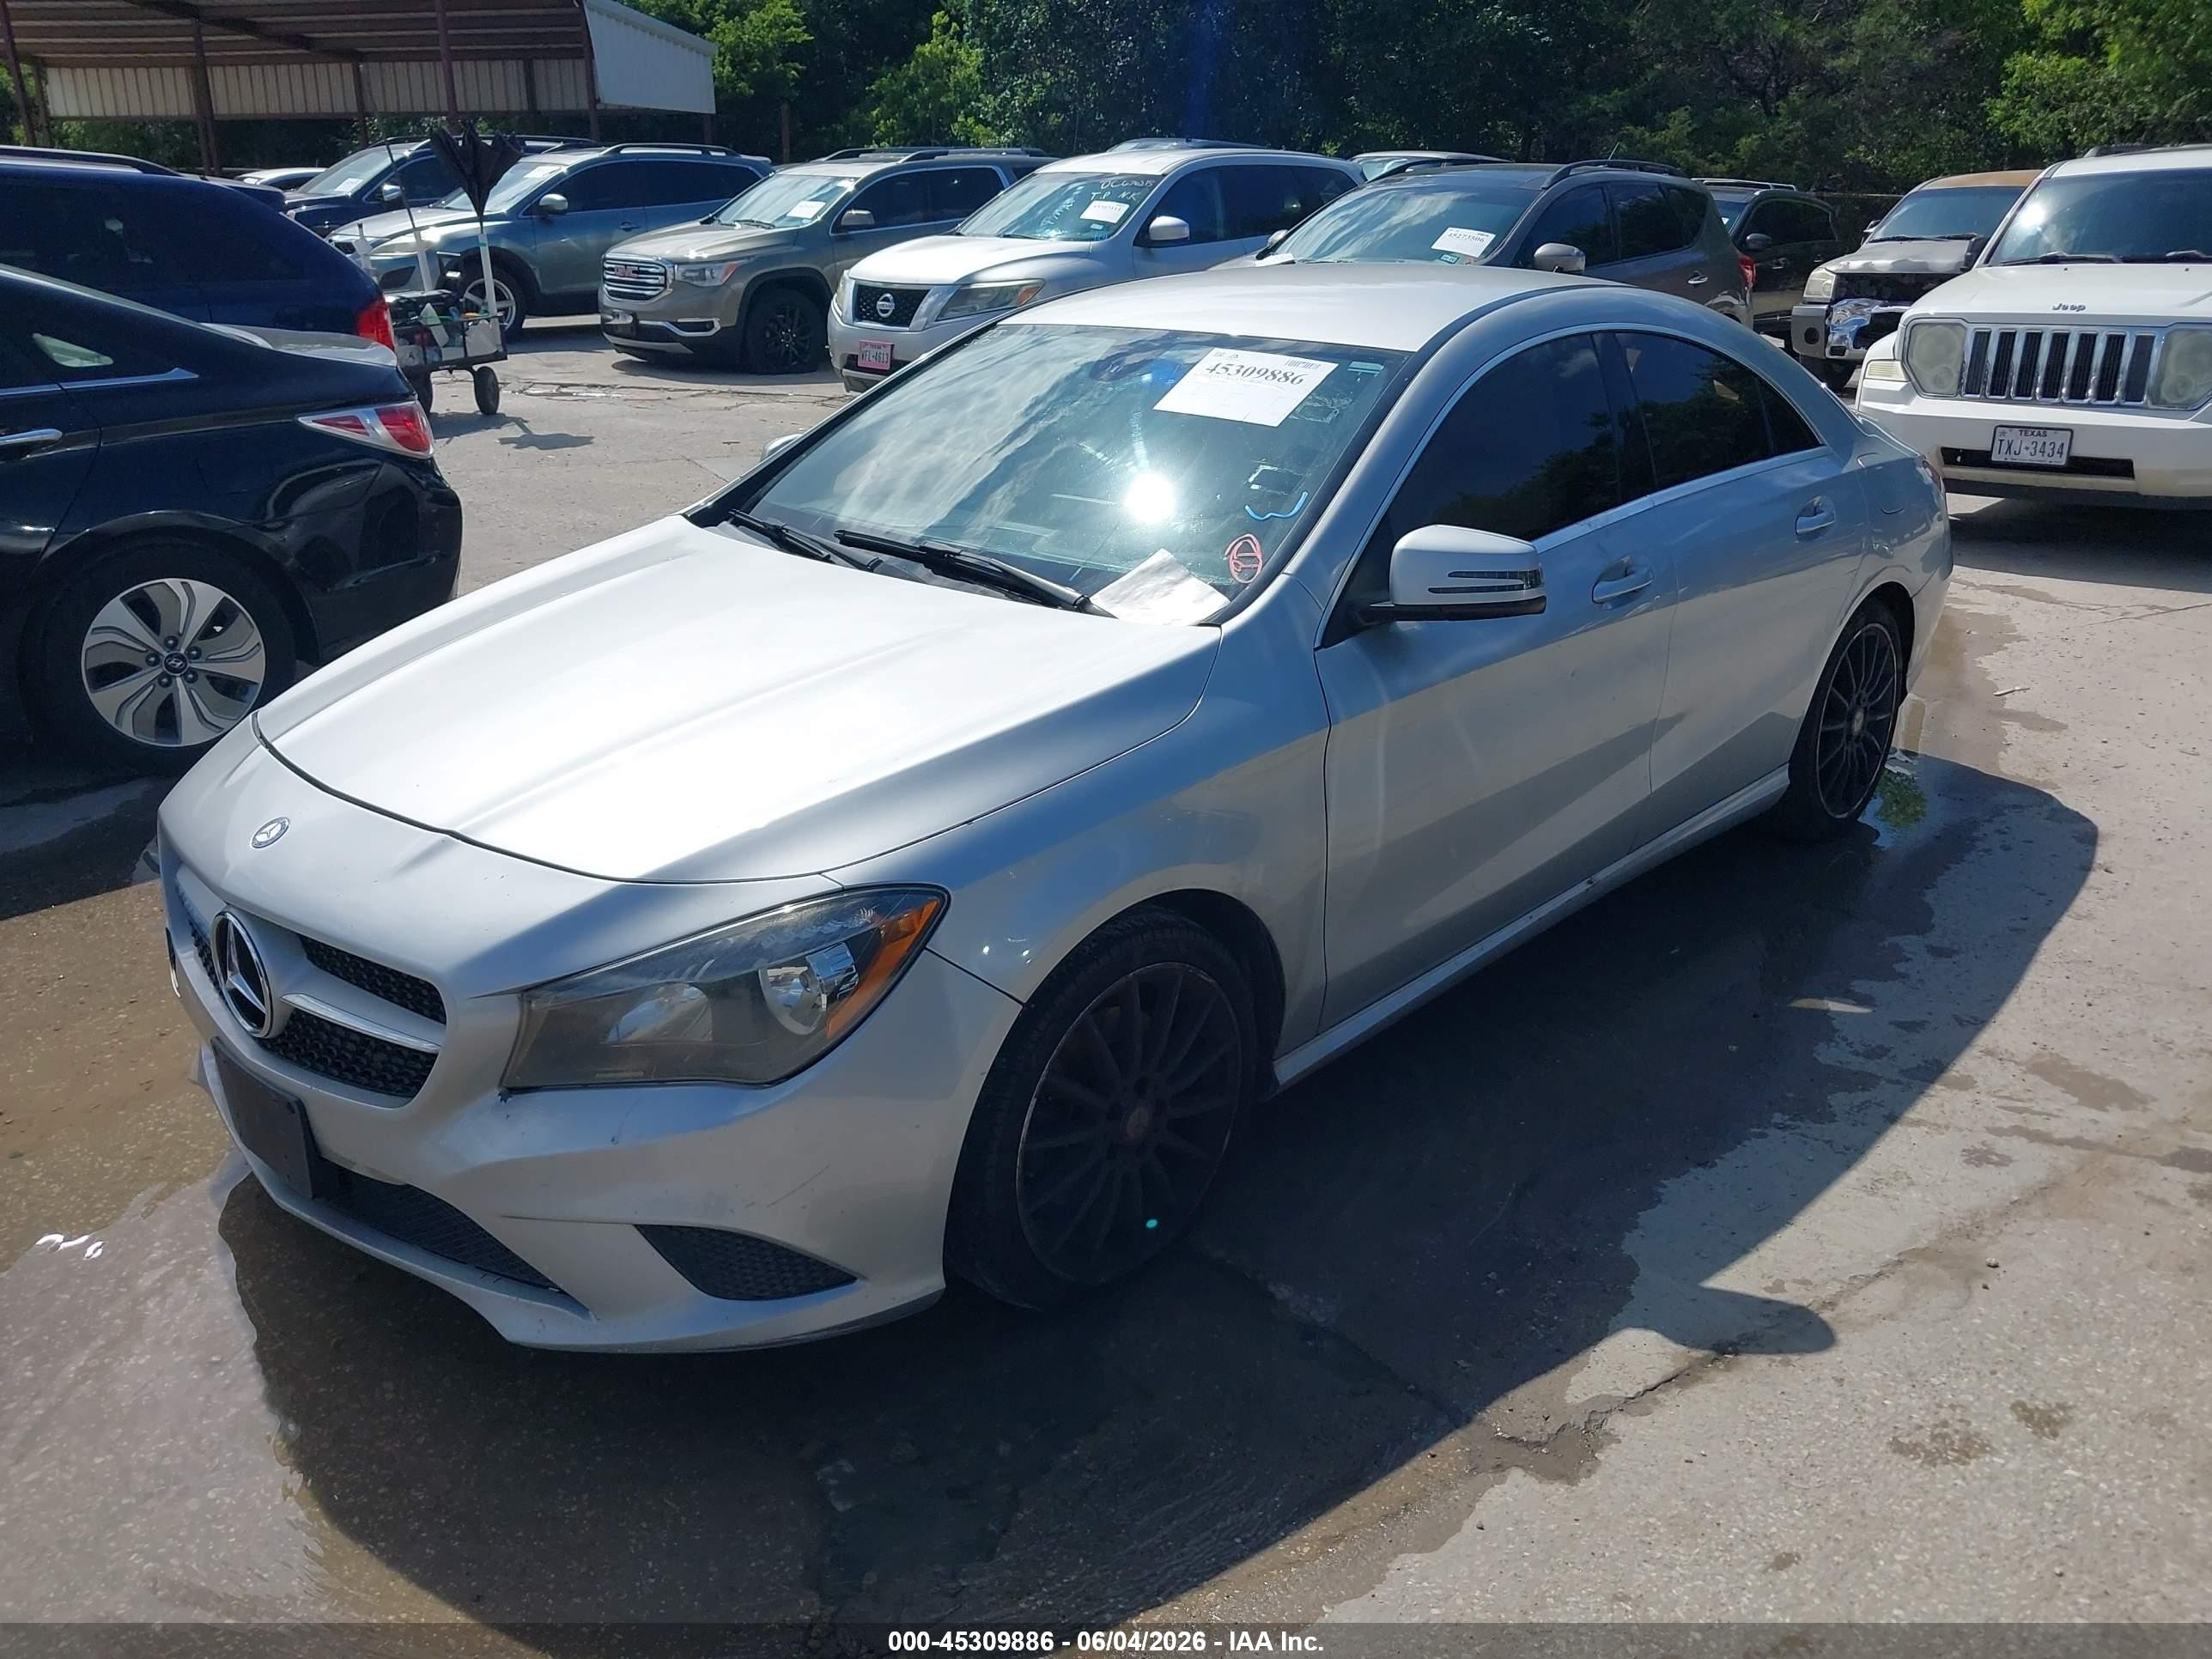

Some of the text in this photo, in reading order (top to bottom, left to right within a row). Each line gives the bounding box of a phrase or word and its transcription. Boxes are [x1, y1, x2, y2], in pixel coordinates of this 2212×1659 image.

[2051, 302, 2087, 313] Jeep
[1206, 362, 1310, 386] 45309886
[2019, 429, 2047, 438] TEXAS
